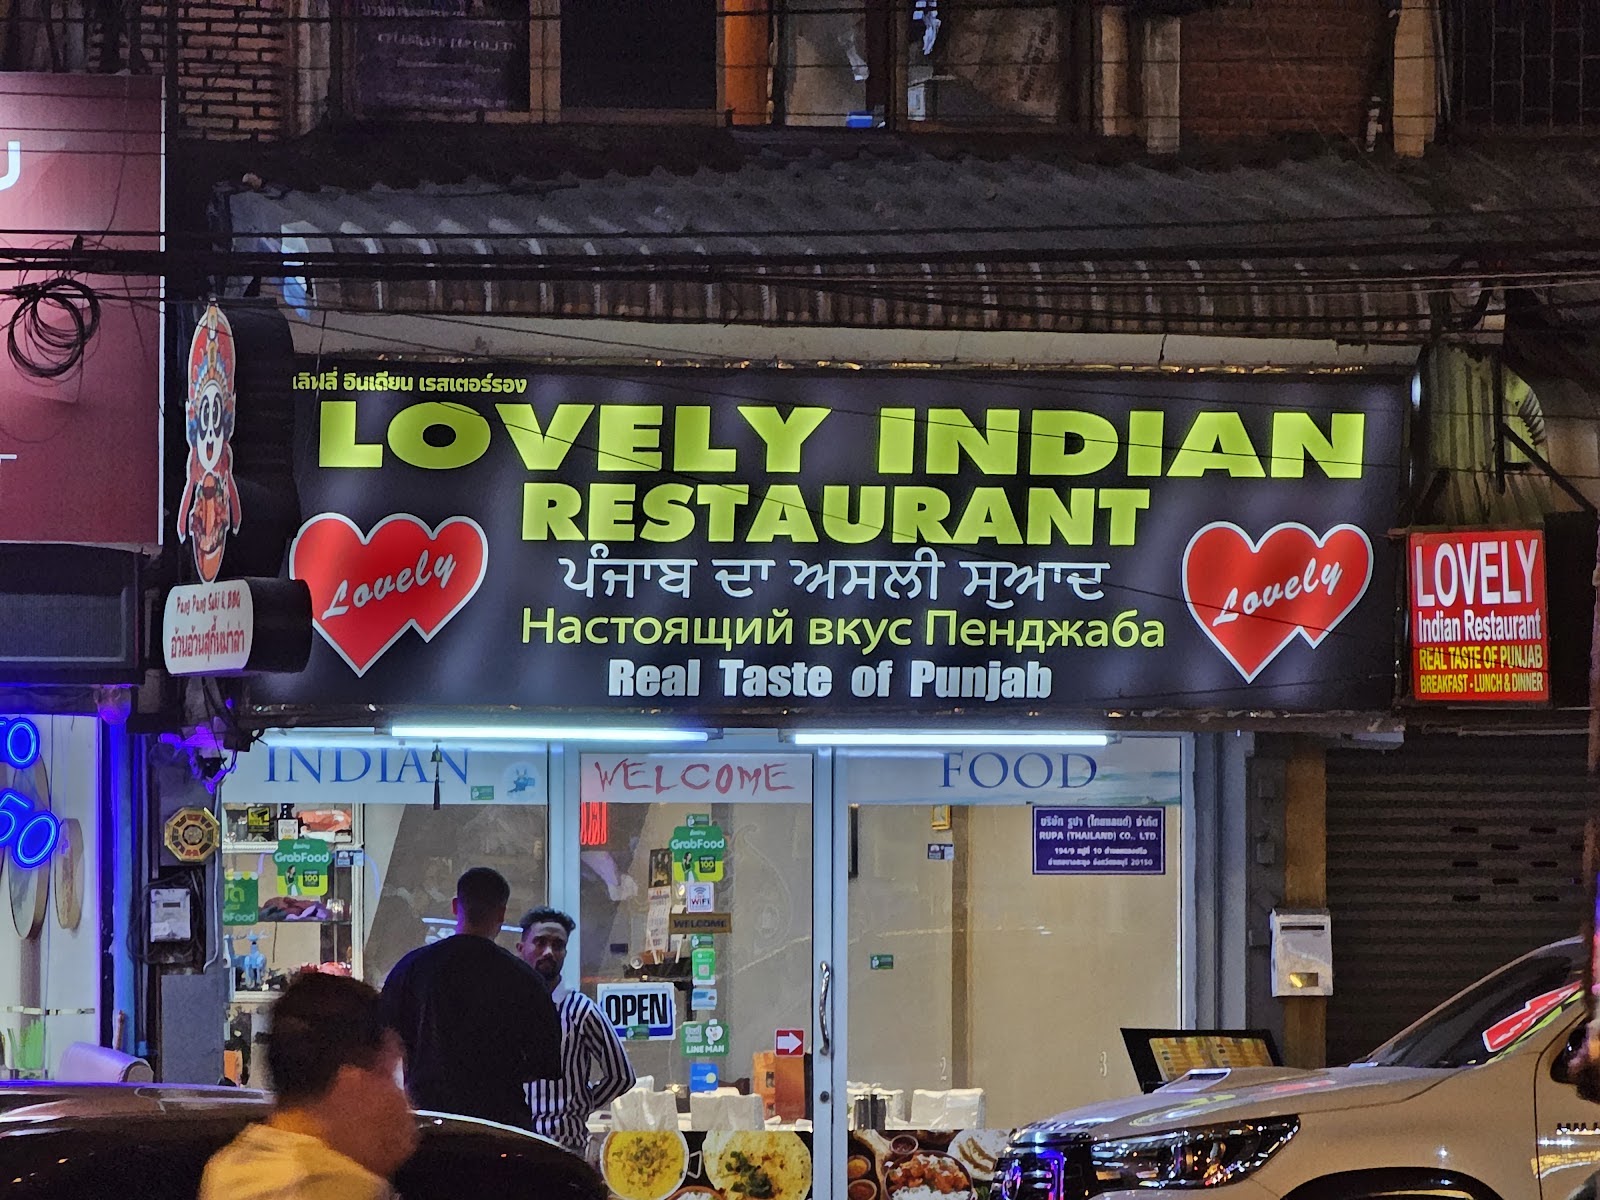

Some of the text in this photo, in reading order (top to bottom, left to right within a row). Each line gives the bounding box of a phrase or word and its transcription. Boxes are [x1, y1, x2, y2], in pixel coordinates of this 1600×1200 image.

[343, 371, 414, 392] อินเดียน
[419, 373, 528, 394] เรสเตอร์รอง
[318, 401, 1365, 479] LOVELY INDIAN
[522, 482, 1150, 546] RESTAURANT
[321, 549, 457, 621] Lovely
[557, 542, 1111, 609] ਪੰਜਾਬ ਦਾ ਅਸਲੀ ਸੁਆਦ
[1415, 539, 1539, 607] LOVELY
[1212, 557, 1343, 627] Lovely
[521, 607, 1165, 655] Настоящий вкус Пенджаба
[1417, 608, 1542, 643] Indian Restaurant
[1419, 644, 1543, 671] REAL TASTE OF PUNJAB
[608, 658, 1052, 701] Real Taste of Punjab
[1420, 671, 1543, 694] BREAKFAST LUNCH & DINNER
[264, 746, 472, 785] INDIAN
[594, 757, 796, 796] WELCOME
[938, 750, 1097, 789] FOOD
[671, 838, 725, 850] GrabFood
[1039, 831, 1064, 840] RUPA
[1067, 831, 1117, 841] (THAILAND)
[1139, 832, 1159, 840] LTD.
[1093, 847, 1102, 855] 10
[274, 851, 330, 863] GrabFood
[673, 919, 725, 928] WELCOME
[605, 993, 668, 1026] OPEN
[686, 1045, 725, 1054] LINE MAN
